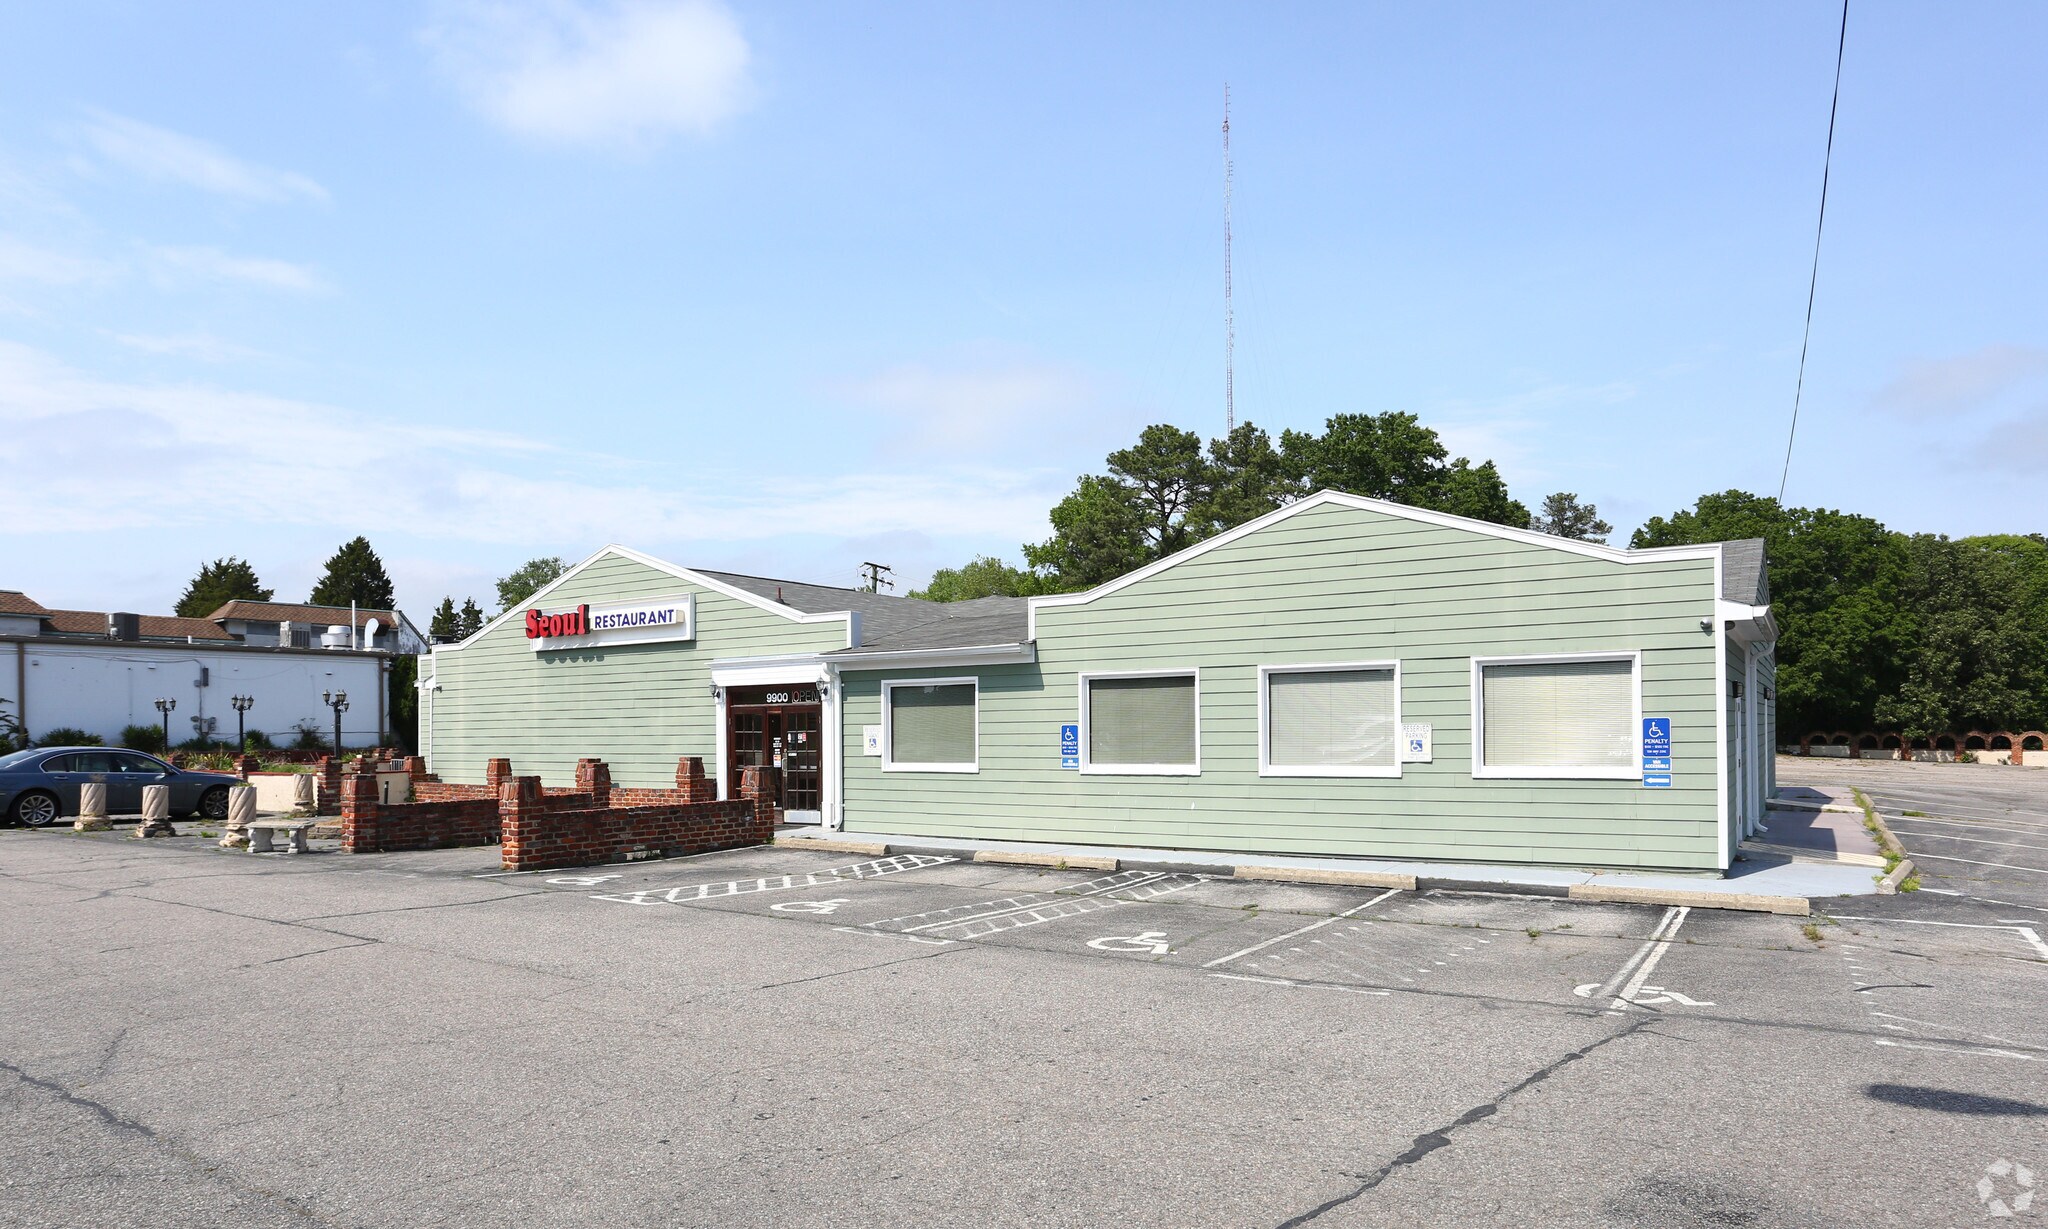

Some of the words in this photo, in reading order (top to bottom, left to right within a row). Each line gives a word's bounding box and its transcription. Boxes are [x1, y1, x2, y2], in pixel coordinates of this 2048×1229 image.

[525, 604, 590, 639] Seoul
[594, 609, 674, 629] RESTAURANT
[766, 692, 789, 703] 9900
[793, 690, 820, 703] OPEN
